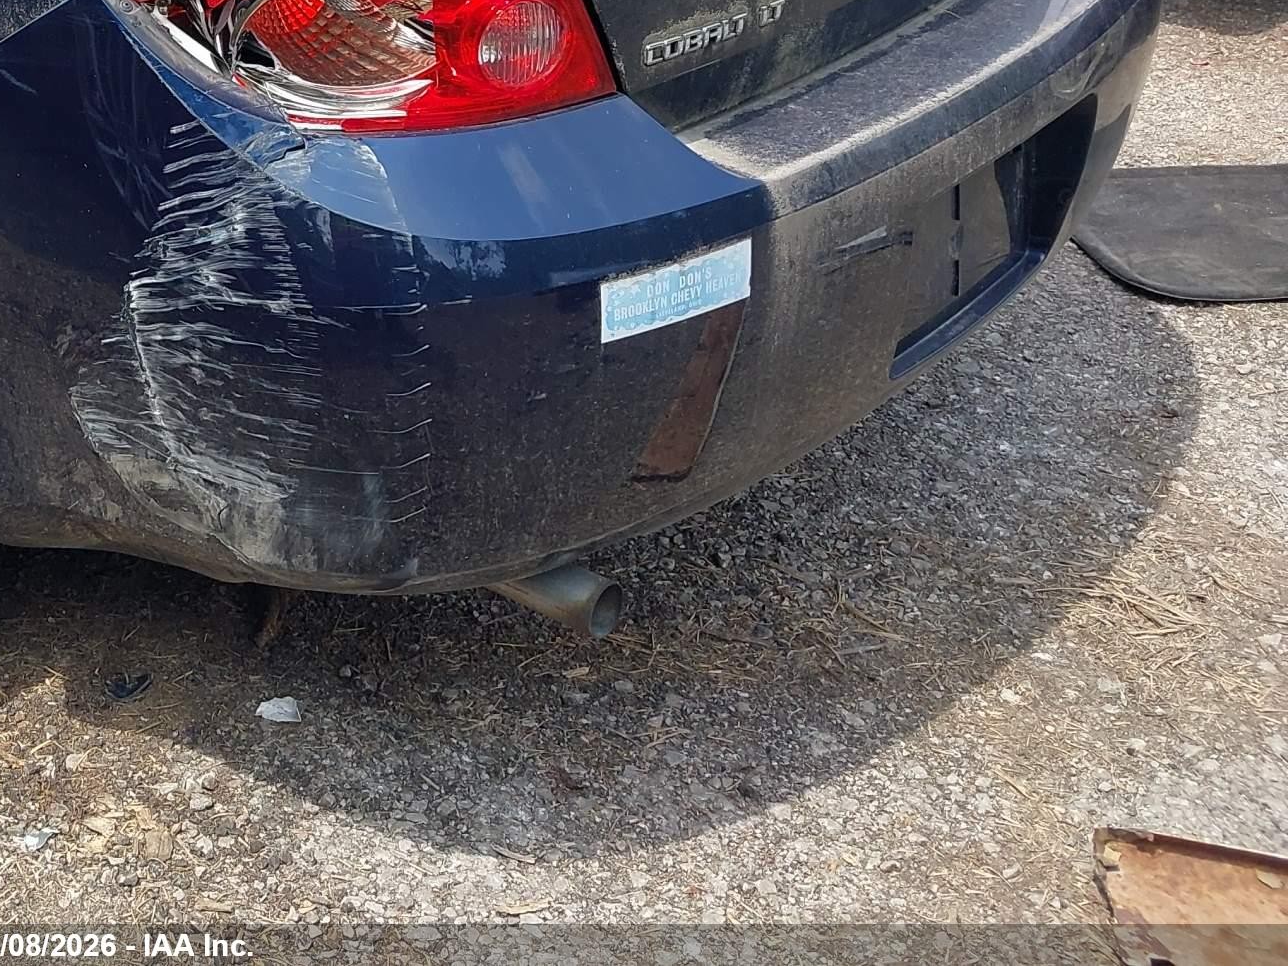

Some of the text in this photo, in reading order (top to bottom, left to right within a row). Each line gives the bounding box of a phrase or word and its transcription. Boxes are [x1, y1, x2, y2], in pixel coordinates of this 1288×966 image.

[643, 12, 748, 66] COBALT
[614, 272, 742, 322] BROOKLYN CHEVY HEAVEN
[647, 267, 712, 297] DON DON'S
